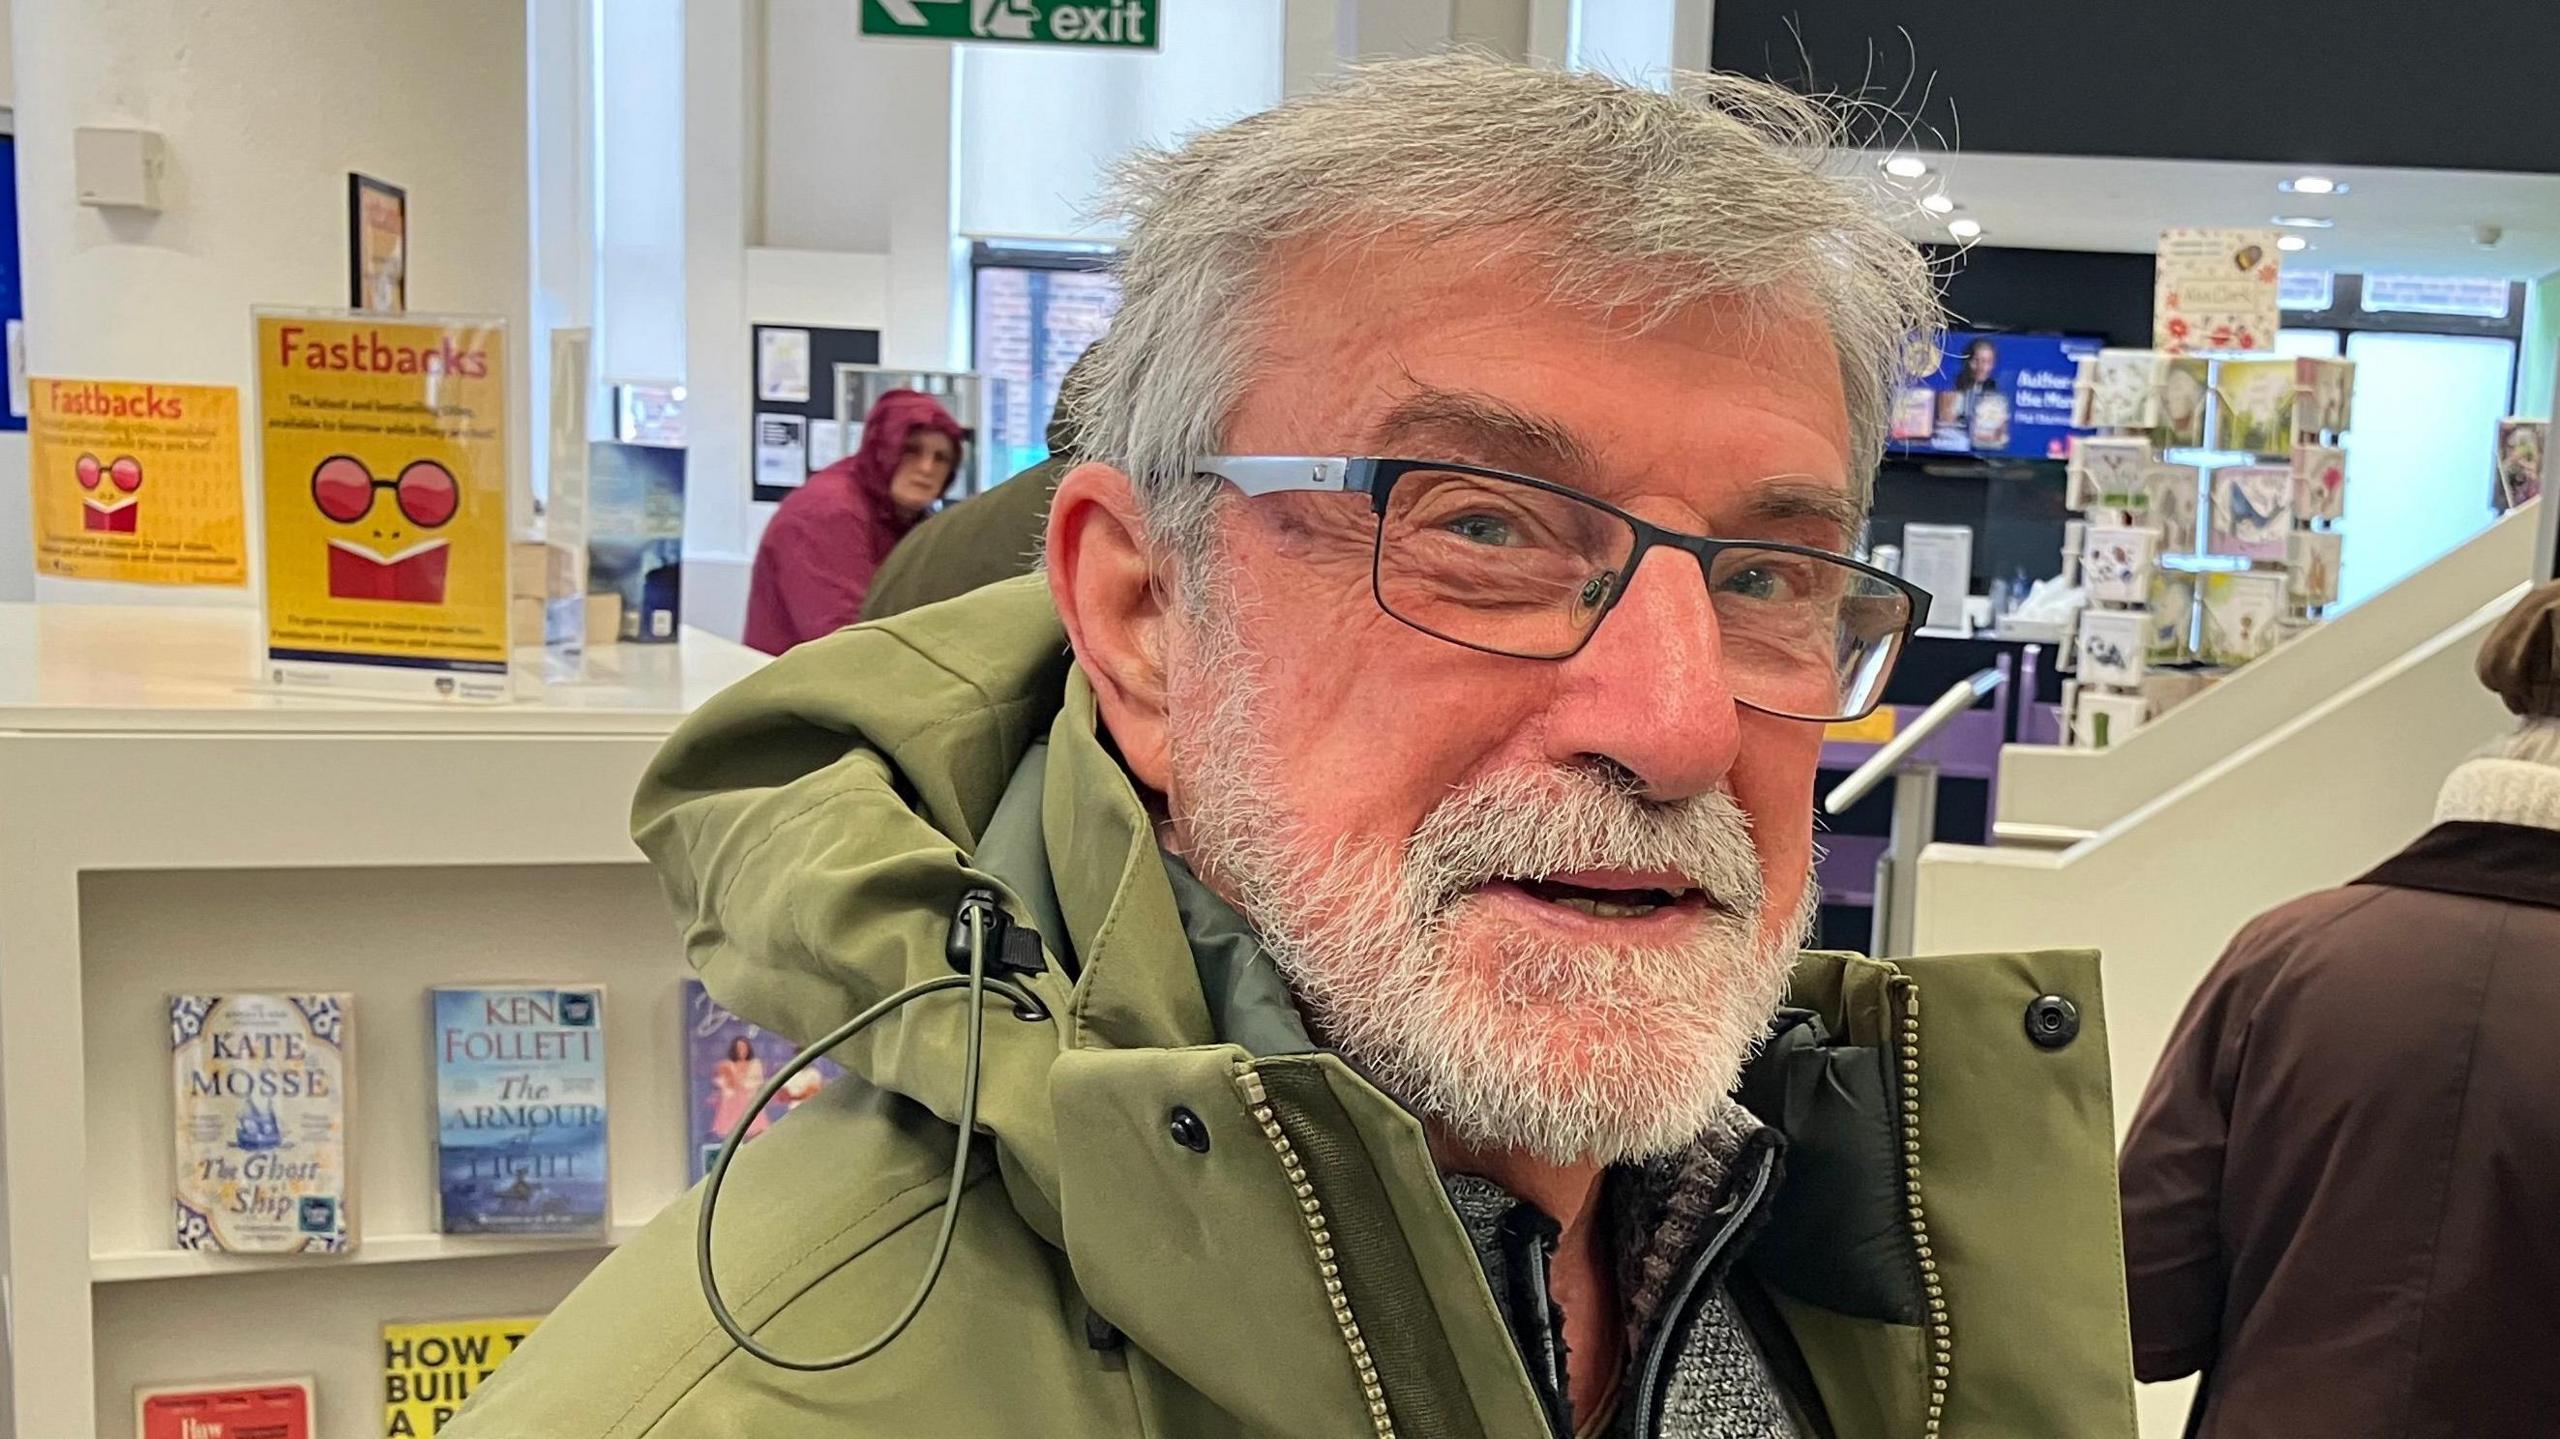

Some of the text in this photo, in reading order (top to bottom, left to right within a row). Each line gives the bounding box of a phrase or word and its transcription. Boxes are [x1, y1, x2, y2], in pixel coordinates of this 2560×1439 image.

[1050, 0, 1146, 43] exit
[280, 328, 488, 378] Fastbacks
[51, 381, 183, 419] Fastbacks
[485, 998, 555, 1026] KEN
[212, 1032, 306, 1061] KATE
[190, 1068, 330, 1099] MOSSE
[499, 1074, 548, 1101] The
[447, 1104, 600, 1130] ARMOUR
[230, 1186, 294, 1221] Ship
[385, 1335, 490, 1368] HOW
[388, 1409, 415, 1438] A
